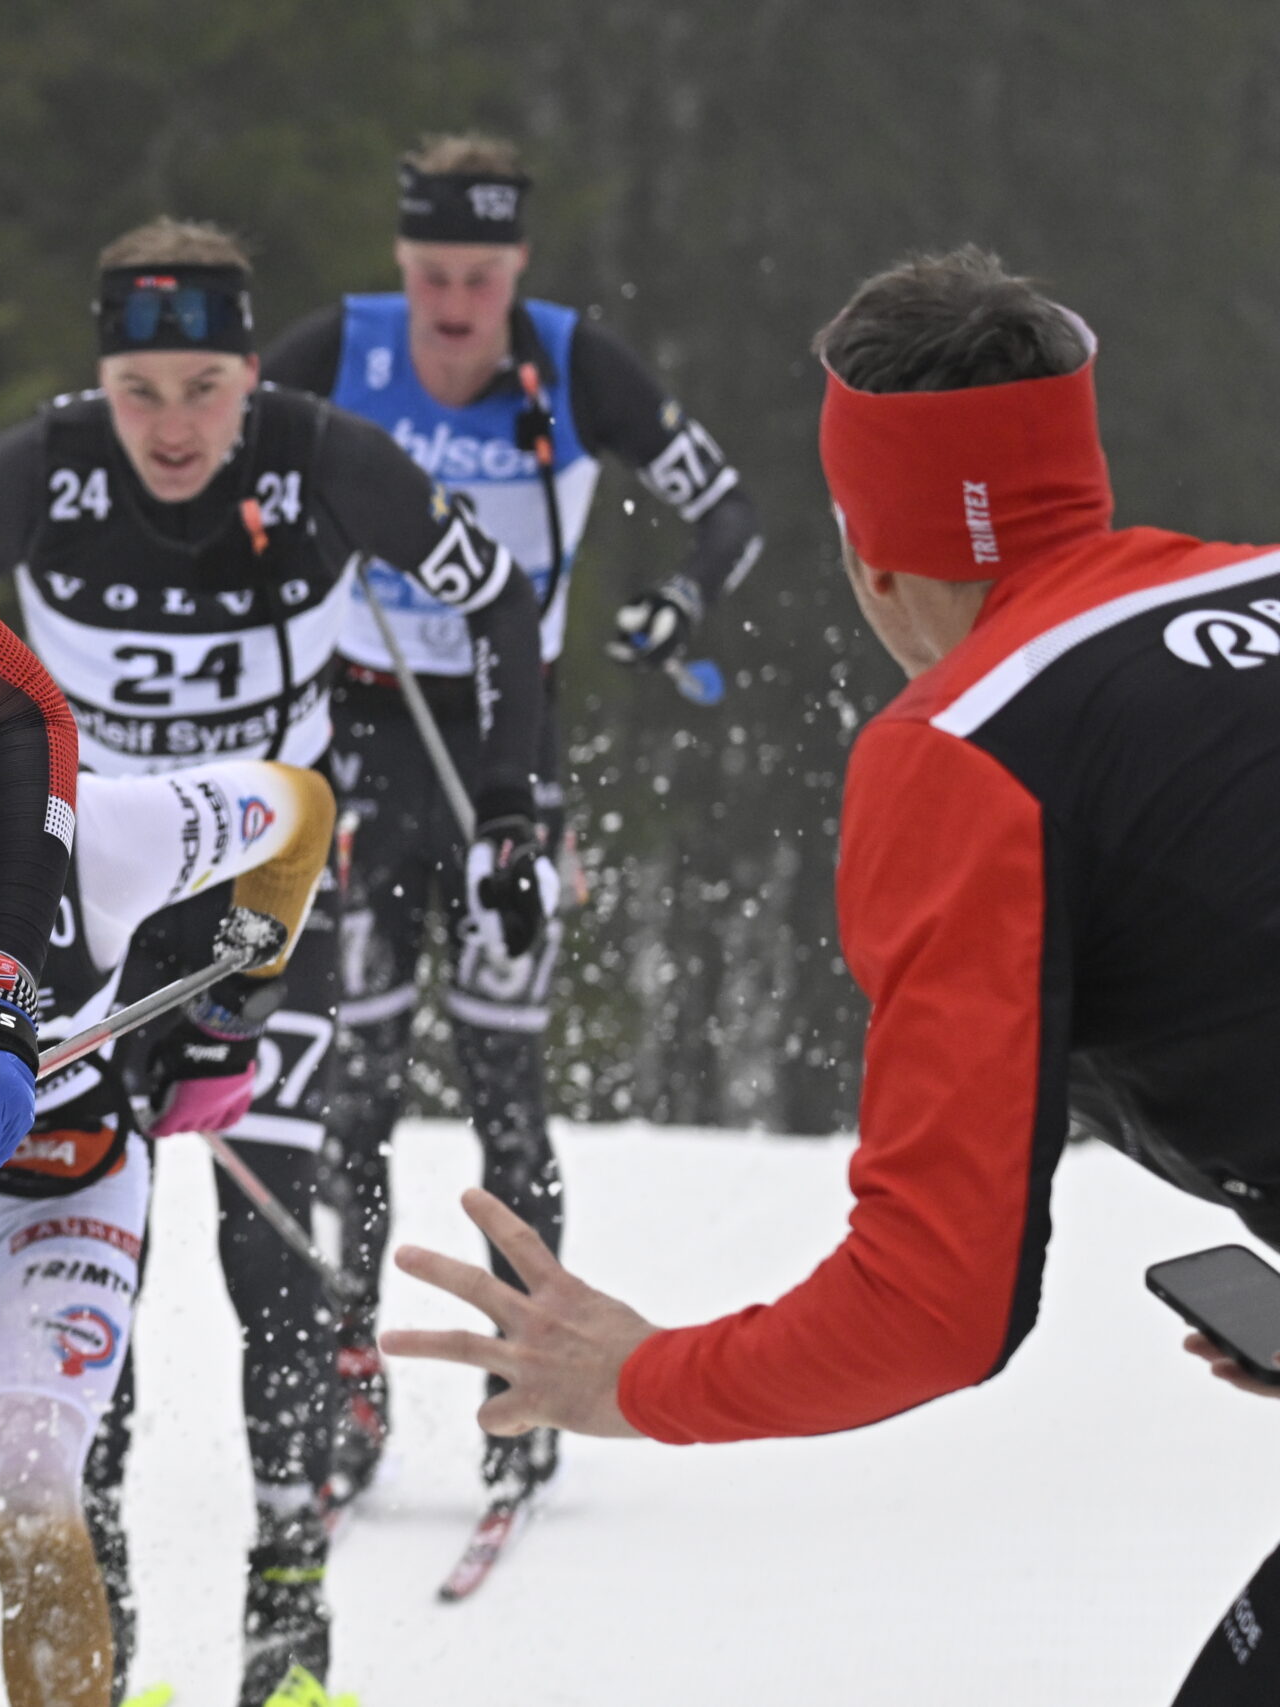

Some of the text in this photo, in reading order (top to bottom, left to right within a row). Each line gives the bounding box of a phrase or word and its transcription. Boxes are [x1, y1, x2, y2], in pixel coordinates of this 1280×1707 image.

[49, 468, 111, 521] 24
[257, 471, 302, 527] 24
[963, 480, 1000, 564] TRIMTEX
[45, 570, 310, 615] VOLVO
[111, 641, 242, 706] 24
